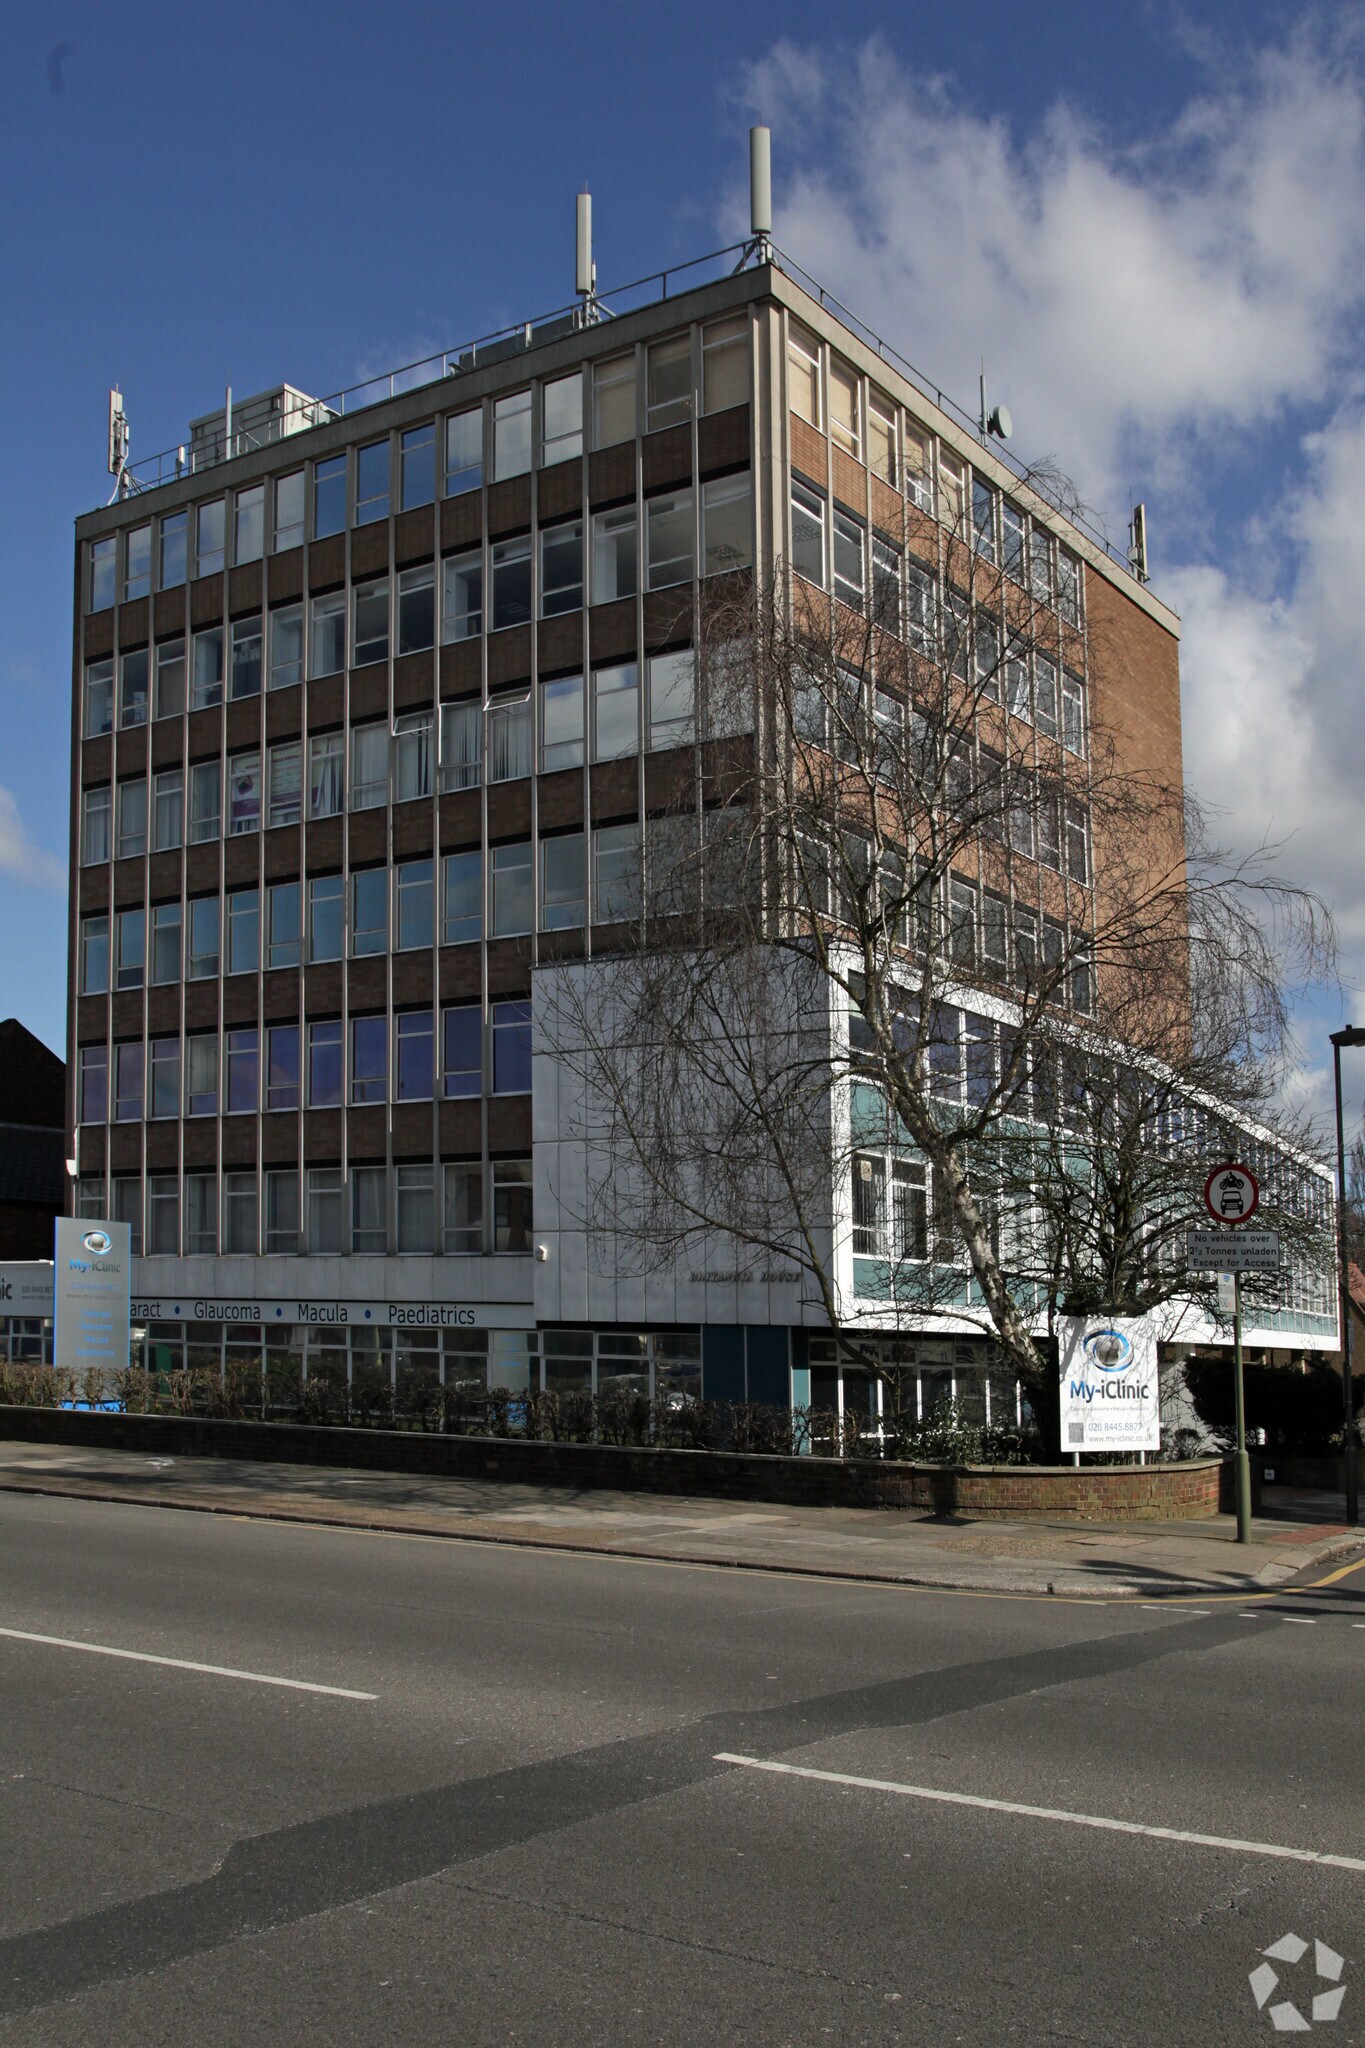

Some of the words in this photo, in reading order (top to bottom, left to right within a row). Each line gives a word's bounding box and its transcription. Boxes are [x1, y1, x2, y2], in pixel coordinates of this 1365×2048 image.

[1195, 1234, 1207, 1242] No
[1211, 1234, 1247, 1242] vehicles
[1206, 1247, 1237, 1255] Tonnes
[1241, 1247, 1277, 1255] unladen
[69, 1258, 121, 1274] My-iClinic
[1193, 1259, 1224, 1268] Except
[1227, 1259, 1240, 1267] for
[1244, 1259, 1276, 1267] Access
[194, 1302, 261, 1320] Glaucoma
[298, 1304, 348, 1322] Macula
[388, 1305, 476, 1325] Paediatrics
[1070, 1379, 1149, 1403] My-iClinic
[1088, 1423, 1102, 1432] 020
[1104, 1422, 1123, 1432] 8445
[1124, 1422, 1143, 1432] 8877
